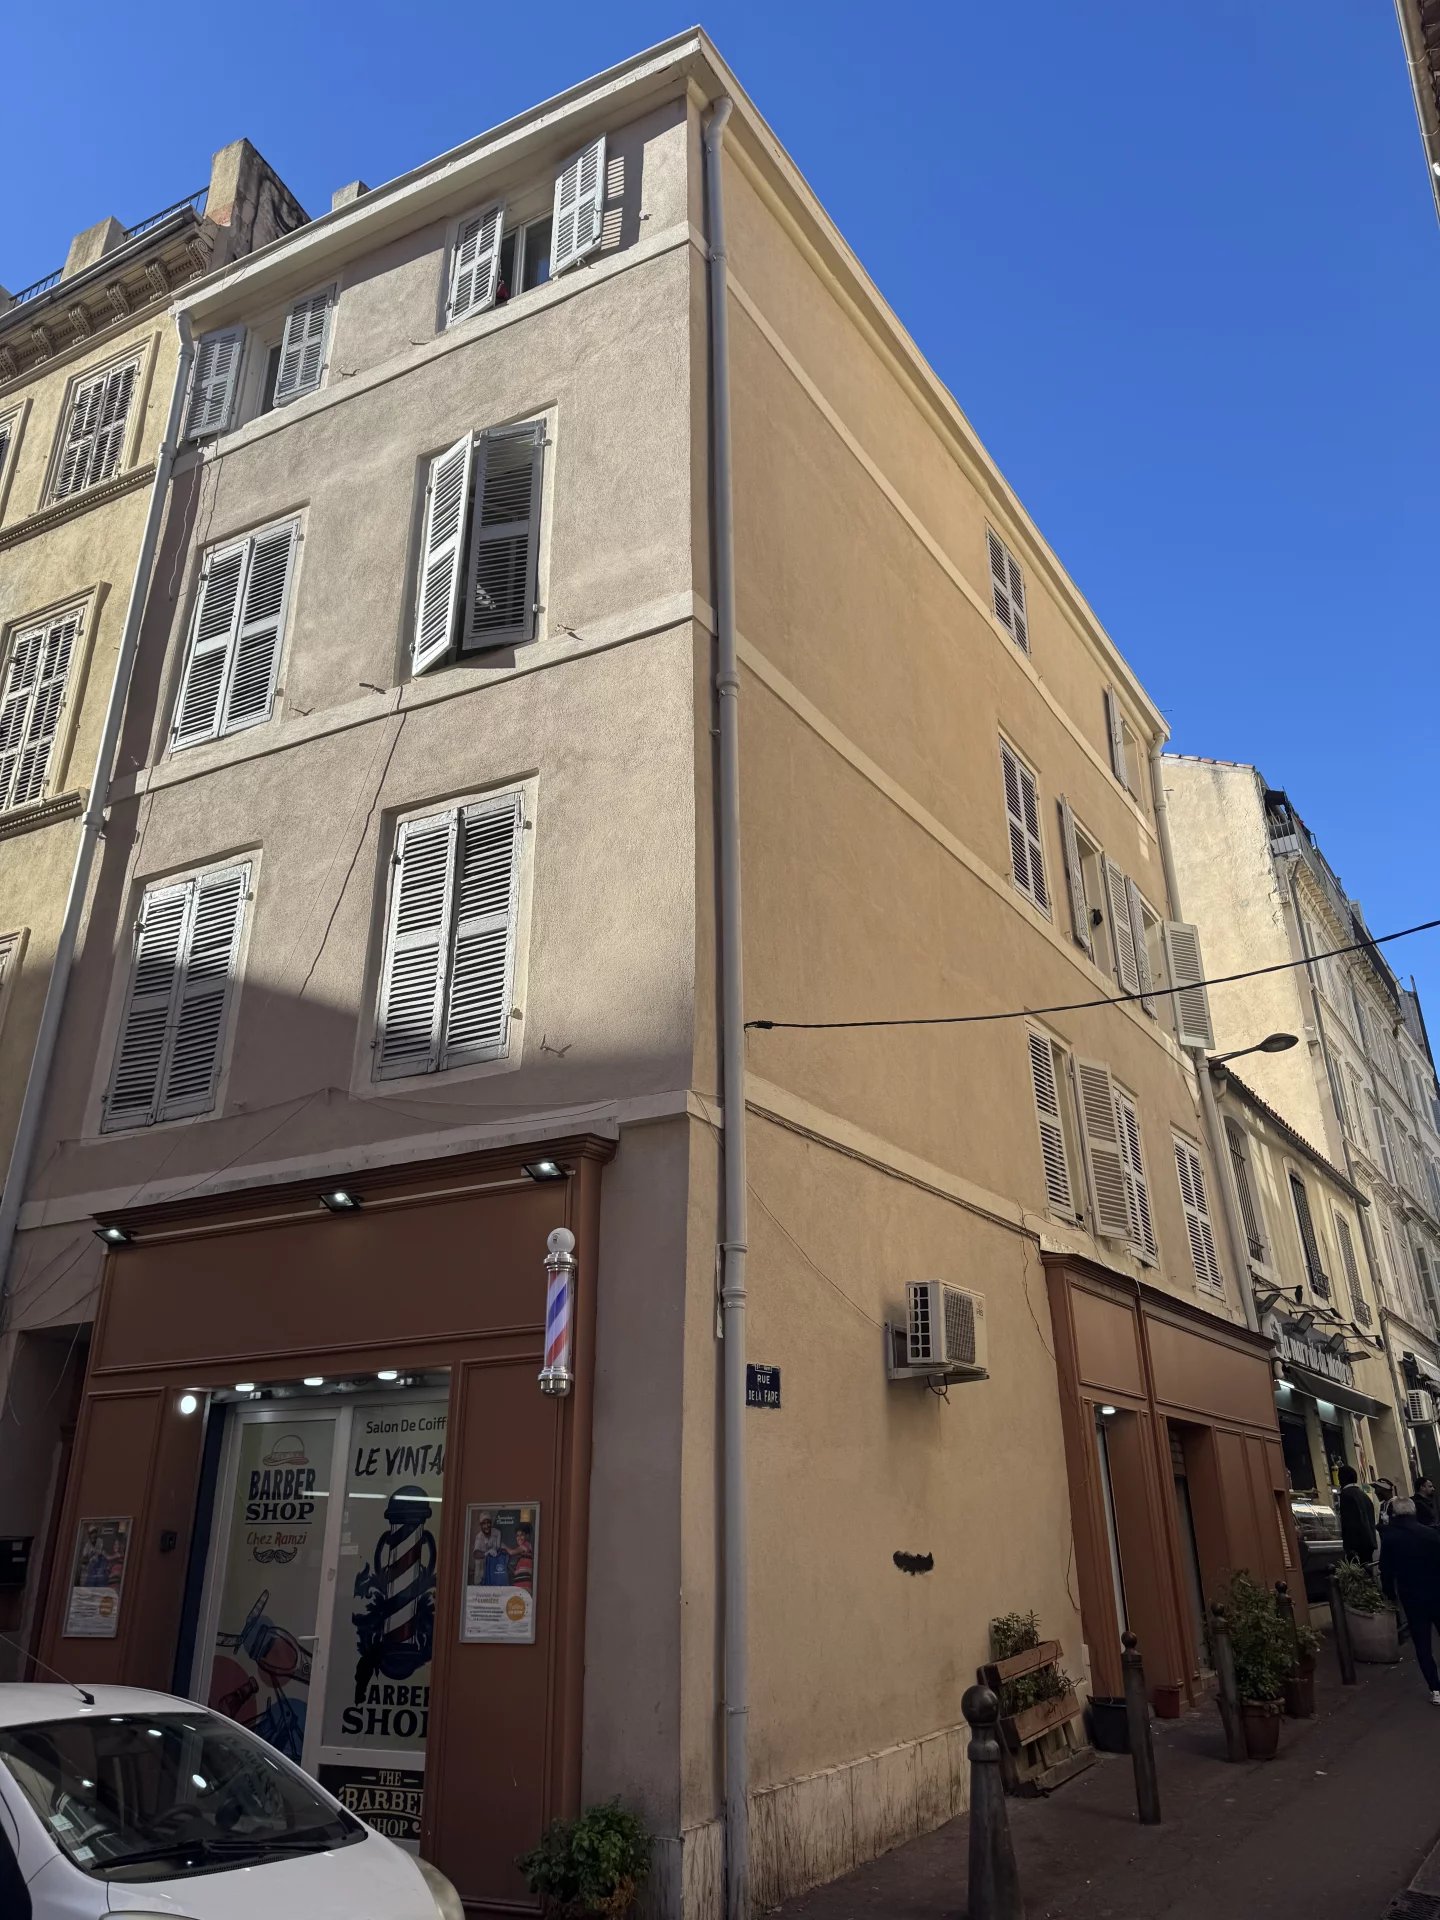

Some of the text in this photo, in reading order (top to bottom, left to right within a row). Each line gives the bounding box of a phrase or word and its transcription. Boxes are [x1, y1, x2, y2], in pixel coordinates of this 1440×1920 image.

[757, 1374, 770, 1384] RUE
[366, 1420, 399, 1434] Salon
[400, 1418, 416, 1432] De
[355, 1444, 446, 1477] LE VINTA
[249, 1469, 316, 1501] BARBER
[246, 1502, 315, 1521] SHOP
[246, 1531, 308, 1547] Chez Ramzi
[378, 1770, 402, 1786] THE
